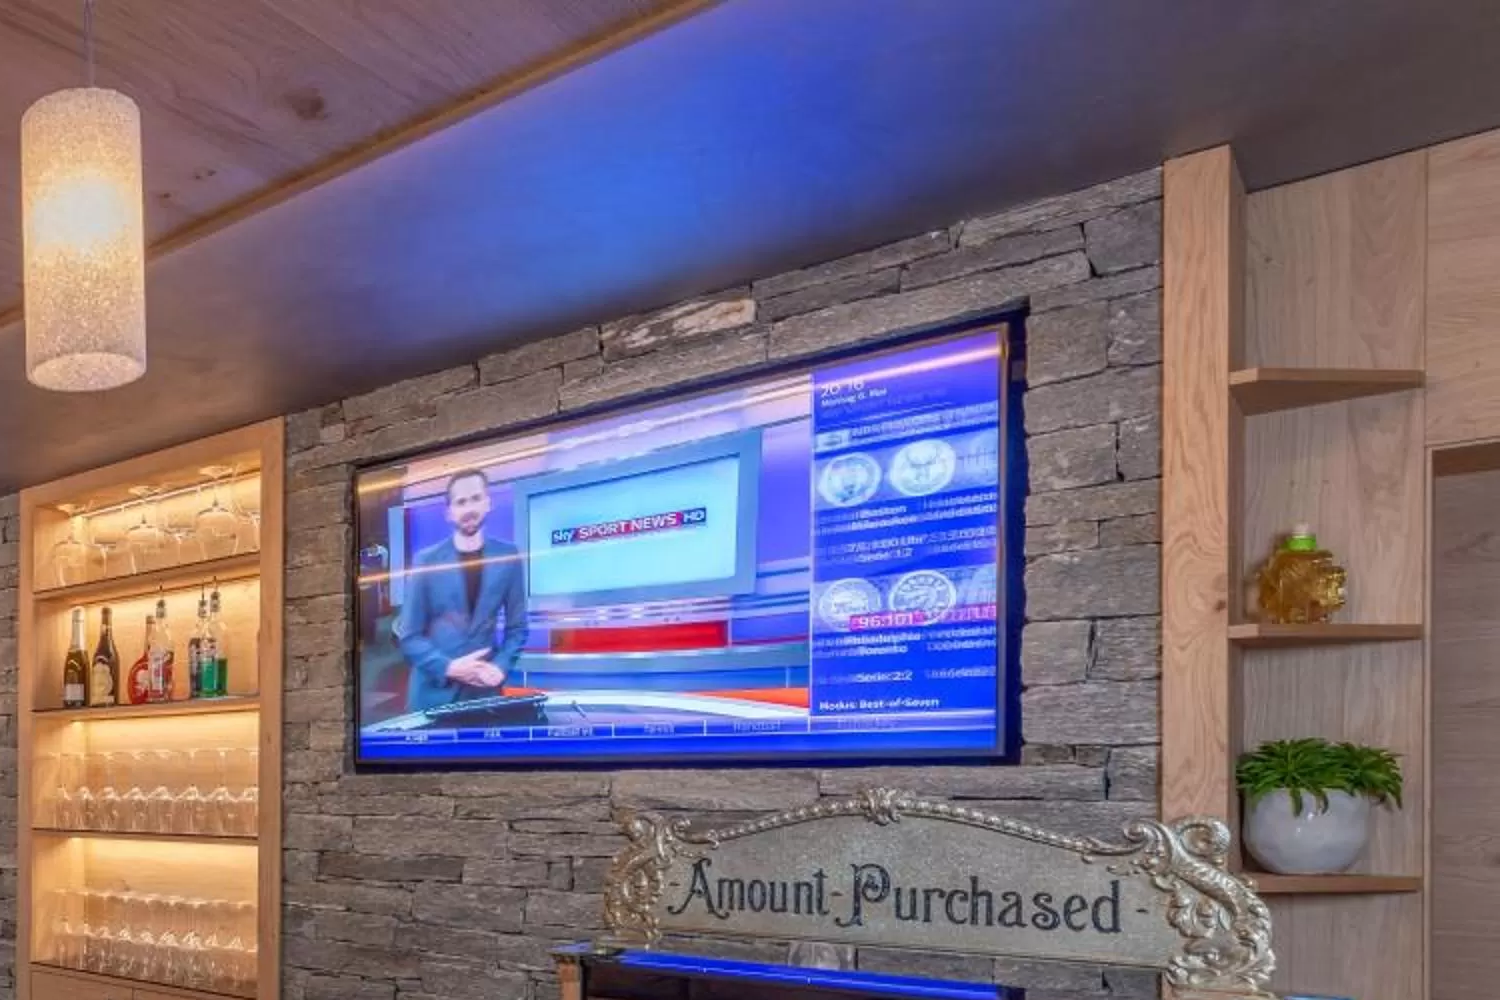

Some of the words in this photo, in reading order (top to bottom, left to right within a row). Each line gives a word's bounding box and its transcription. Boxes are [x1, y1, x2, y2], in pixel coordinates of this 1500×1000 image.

[553, 526, 574, 544] sky
[578, 520, 627, 540] SPORT
[630, 512, 677, 531] NEWS
[683, 509, 705, 523] HD
[667, 857, 829, 919] Amount
[834, 862, 1124, 934] Purchased
